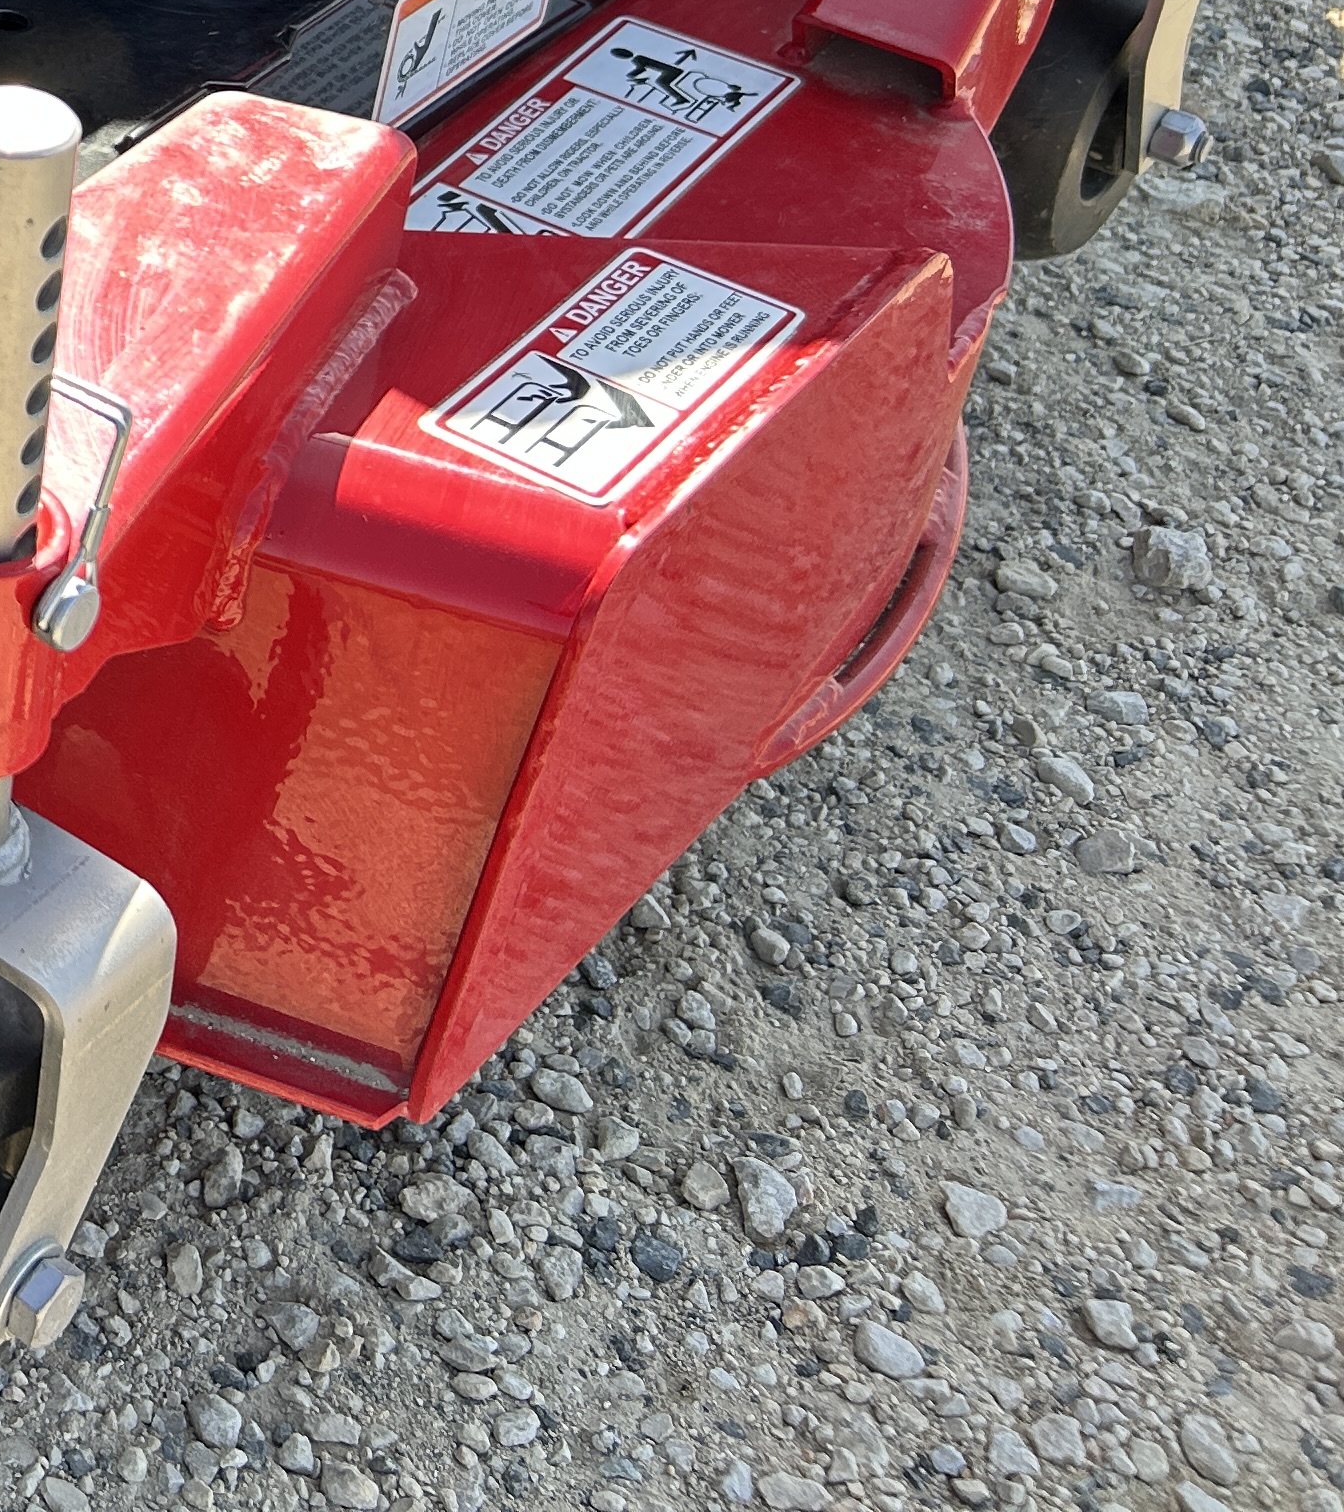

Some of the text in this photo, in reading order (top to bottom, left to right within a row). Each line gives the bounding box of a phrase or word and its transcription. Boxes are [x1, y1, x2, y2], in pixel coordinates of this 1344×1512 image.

[478, 96, 553, 150] DANGER
[563, 259, 652, 325] DANGER
[568, 268, 681, 361] TO AVOID SERIOUS INJURY
[603, 281, 690, 352] FROM SEVERING OF
[621, 335, 653, 358] TOES
[643, 324, 666, 338] OR
[637, 292, 744, 383] DO NOT PUT HANDS OR FEET
[680, 353, 701, 366] OR
[692, 337, 719, 356] INTO
[710, 311, 746, 339] MOWER
[721, 341, 738, 350] IS
[729, 310, 771, 343] RUNNING
